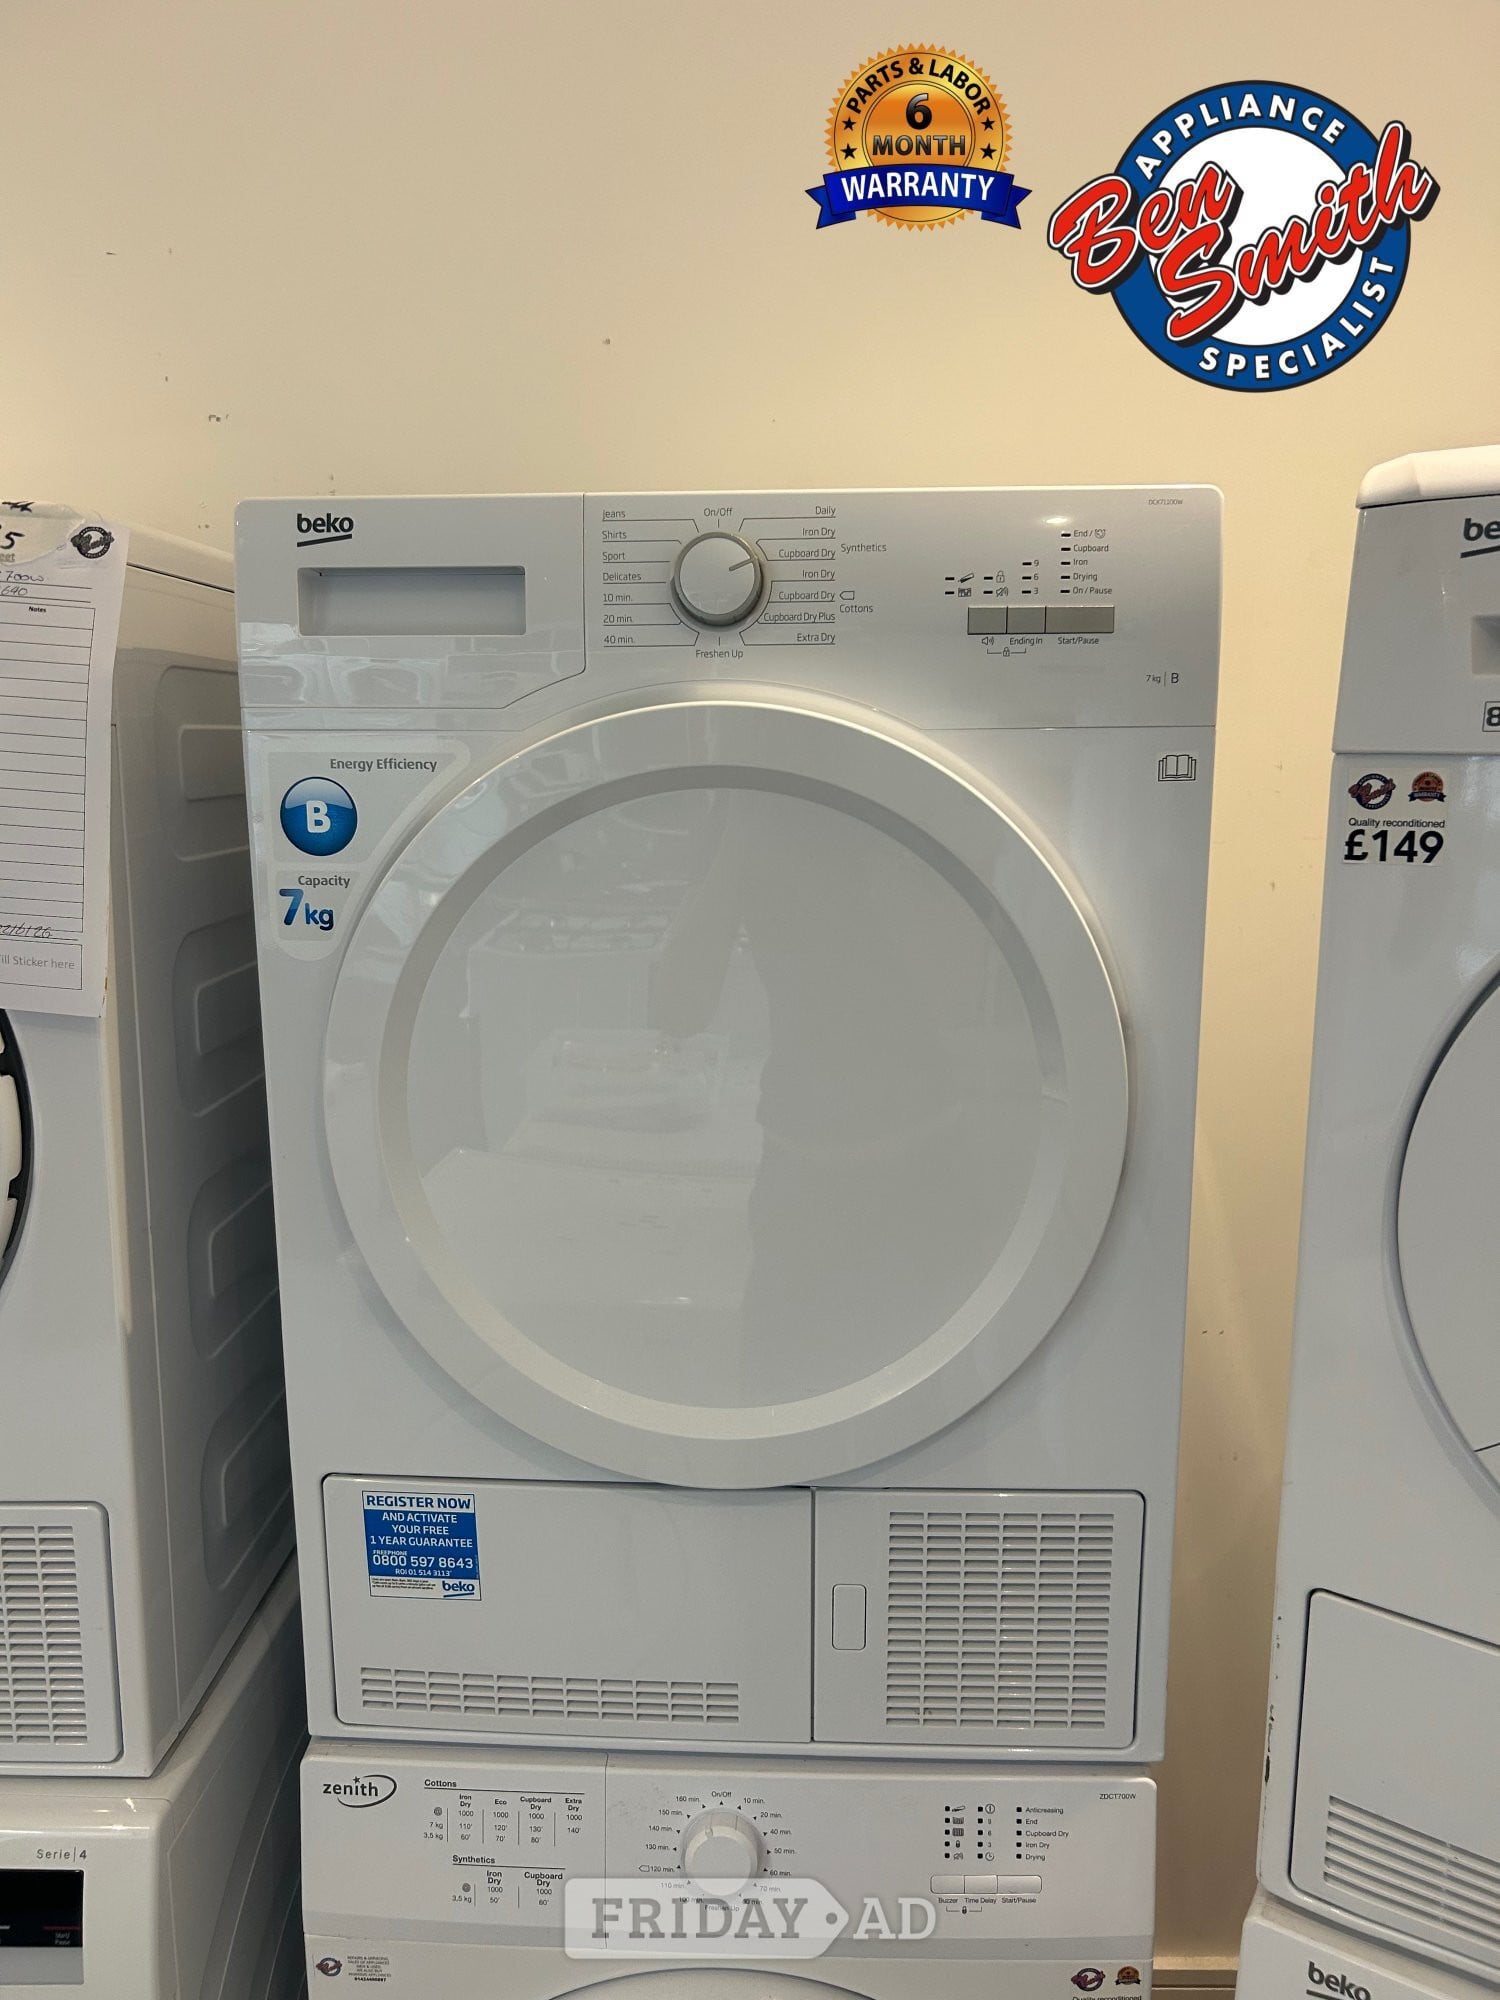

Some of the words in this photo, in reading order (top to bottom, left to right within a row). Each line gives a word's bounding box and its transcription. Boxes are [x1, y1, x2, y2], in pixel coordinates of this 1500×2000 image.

[602, 509, 626, 520] Jeans
[703, 507, 734, 517] On/Off
[815, 505, 836, 516] Daily
[296, 512, 354, 534] beko
[601, 530, 627, 539] Shirts
[802, 528, 820, 536] Iron
[821, 528, 836, 538] Dry
[1463, 517, 1500, 542] be
[840, 543, 887, 554] Synthetics
[1073, 544, 1109, 553] Cupboard
[602, 551, 625, 562] Sport
[778, 549, 820, 560] Cupboard
[821, 548, 836, 559] Dry
[602, 572, 642, 581] Delicates
[802, 569, 819, 578] Iron
[820, 569, 836, 580] Dry
[1073, 573, 1098, 582] Drying
[603, 593, 614, 602] 10
[778, 591, 819, 602] Cupboard
[820, 591, 836, 601] Dry
[839, 604, 874, 613] Cottons
[603, 614, 615, 623] 20
[763, 612, 802, 623] Cupboard
[803, 612, 818, 623] Dry
[818, 611, 836, 621] Plus
[603, 635, 616, 644] 40
[796, 633, 819, 642] Extra
[820, 632, 836, 643] Dry
[1009, 637, 1035, 646] Ending
[1057, 636, 1100, 645] Start/Pause
[695, 649, 730, 658] Freshen
[731, 648, 744, 659] Up
[1145, 674, 1151, 682] 7
[1170, 672, 1179, 684] B
[330, 758, 373, 772] Energy
[376, 757, 438, 773] Efficiency
[305, 800, 332, 834] B
[1348, 817, 1381, 829] Quality
[1382, 818, 1446, 829] reconditioned
[1343, 829, 1444, 864] £149
[297, 875, 351, 889] Capacity
[13, 955, 49, 968] Sticker
[50, 957, 75, 970] here
[366, 1494, 434, 1508] REGISTER
[437, 1497, 471, 1510] NOW
[382, 1512, 405, 1522] AND
[406, 1512, 458, 1523] ACTIVATE
[391, 1524, 421, 1534] YOUR
[423, 1525, 449, 1535] FREE
[370, 1535, 377, 1545] 1
[378, 1535, 407, 1545] YEAR
[408, 1536, 473, 1548] GUARANTEE
[372, 1555, 407, 1566] 0800
[410, 1556, 435, 1568] 597
[438, 1557, 474, 1569] 8643
[408, 1568, 417, 1576] 01
[441, 1580, 475, 1592] beko
[322, 1777, 378, 1797] zenith
[424, 1779, 457, 1788] Cottons
[519, 1795, 552, 1803] Cupboard
[711, 1790, 732, 1798] On/Off
[459, 1800, 471, 1808] Dry
[494, 1798, 507, 1806] Eco
[530, 1803, 542, 1811] Dry
[567, 1804, 579, 1812] Dry
[528, 1812, 545, 1820] 1000
[566, 1813, 583, 1821] 1000
[429, 1821, 434, 1829] 7
[1057, 1830, 1069, 1838] Dry
[1038, 1841, 1050, 1849] Dry
[36, 1848, 71, 1860] Serie
[79, 1849, 87, 1859] 4
[452, 1854, 496, 1864] Synthetics
[1025, 1853, 1046, 1861] Drying
[524, 1871, 563, 1880] Cupboard
[487, 1876, 502, 1886] Dry
[536, 1879, 550, 1888] Dry
[980, 1897, 997, 1905] Delay
[1308, 1960, 1372, 2000] beko
